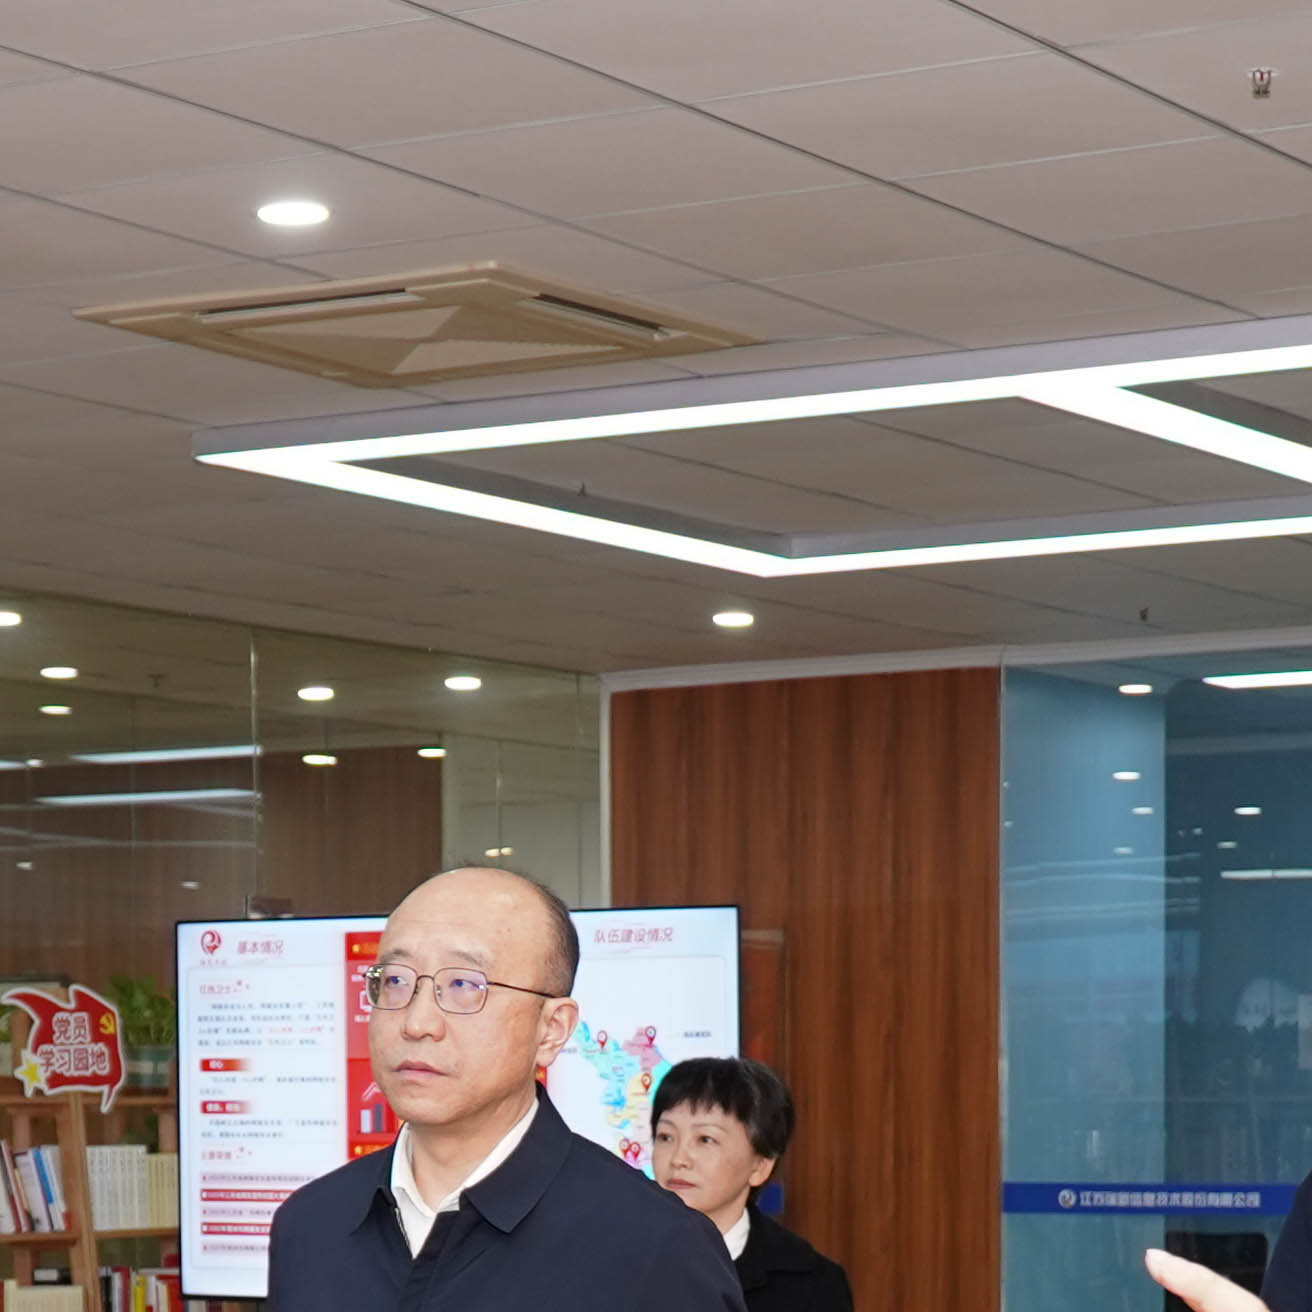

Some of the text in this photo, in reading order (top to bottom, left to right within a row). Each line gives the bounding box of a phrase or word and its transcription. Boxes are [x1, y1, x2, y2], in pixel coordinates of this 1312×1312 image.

[593, 927, 674, 944] 队伍建设情况
[237, 939, 285, 956] 基本情况
[53, 1013, 89, 1042] 党员
[38, 1045, 108, 1074] 学习园地
